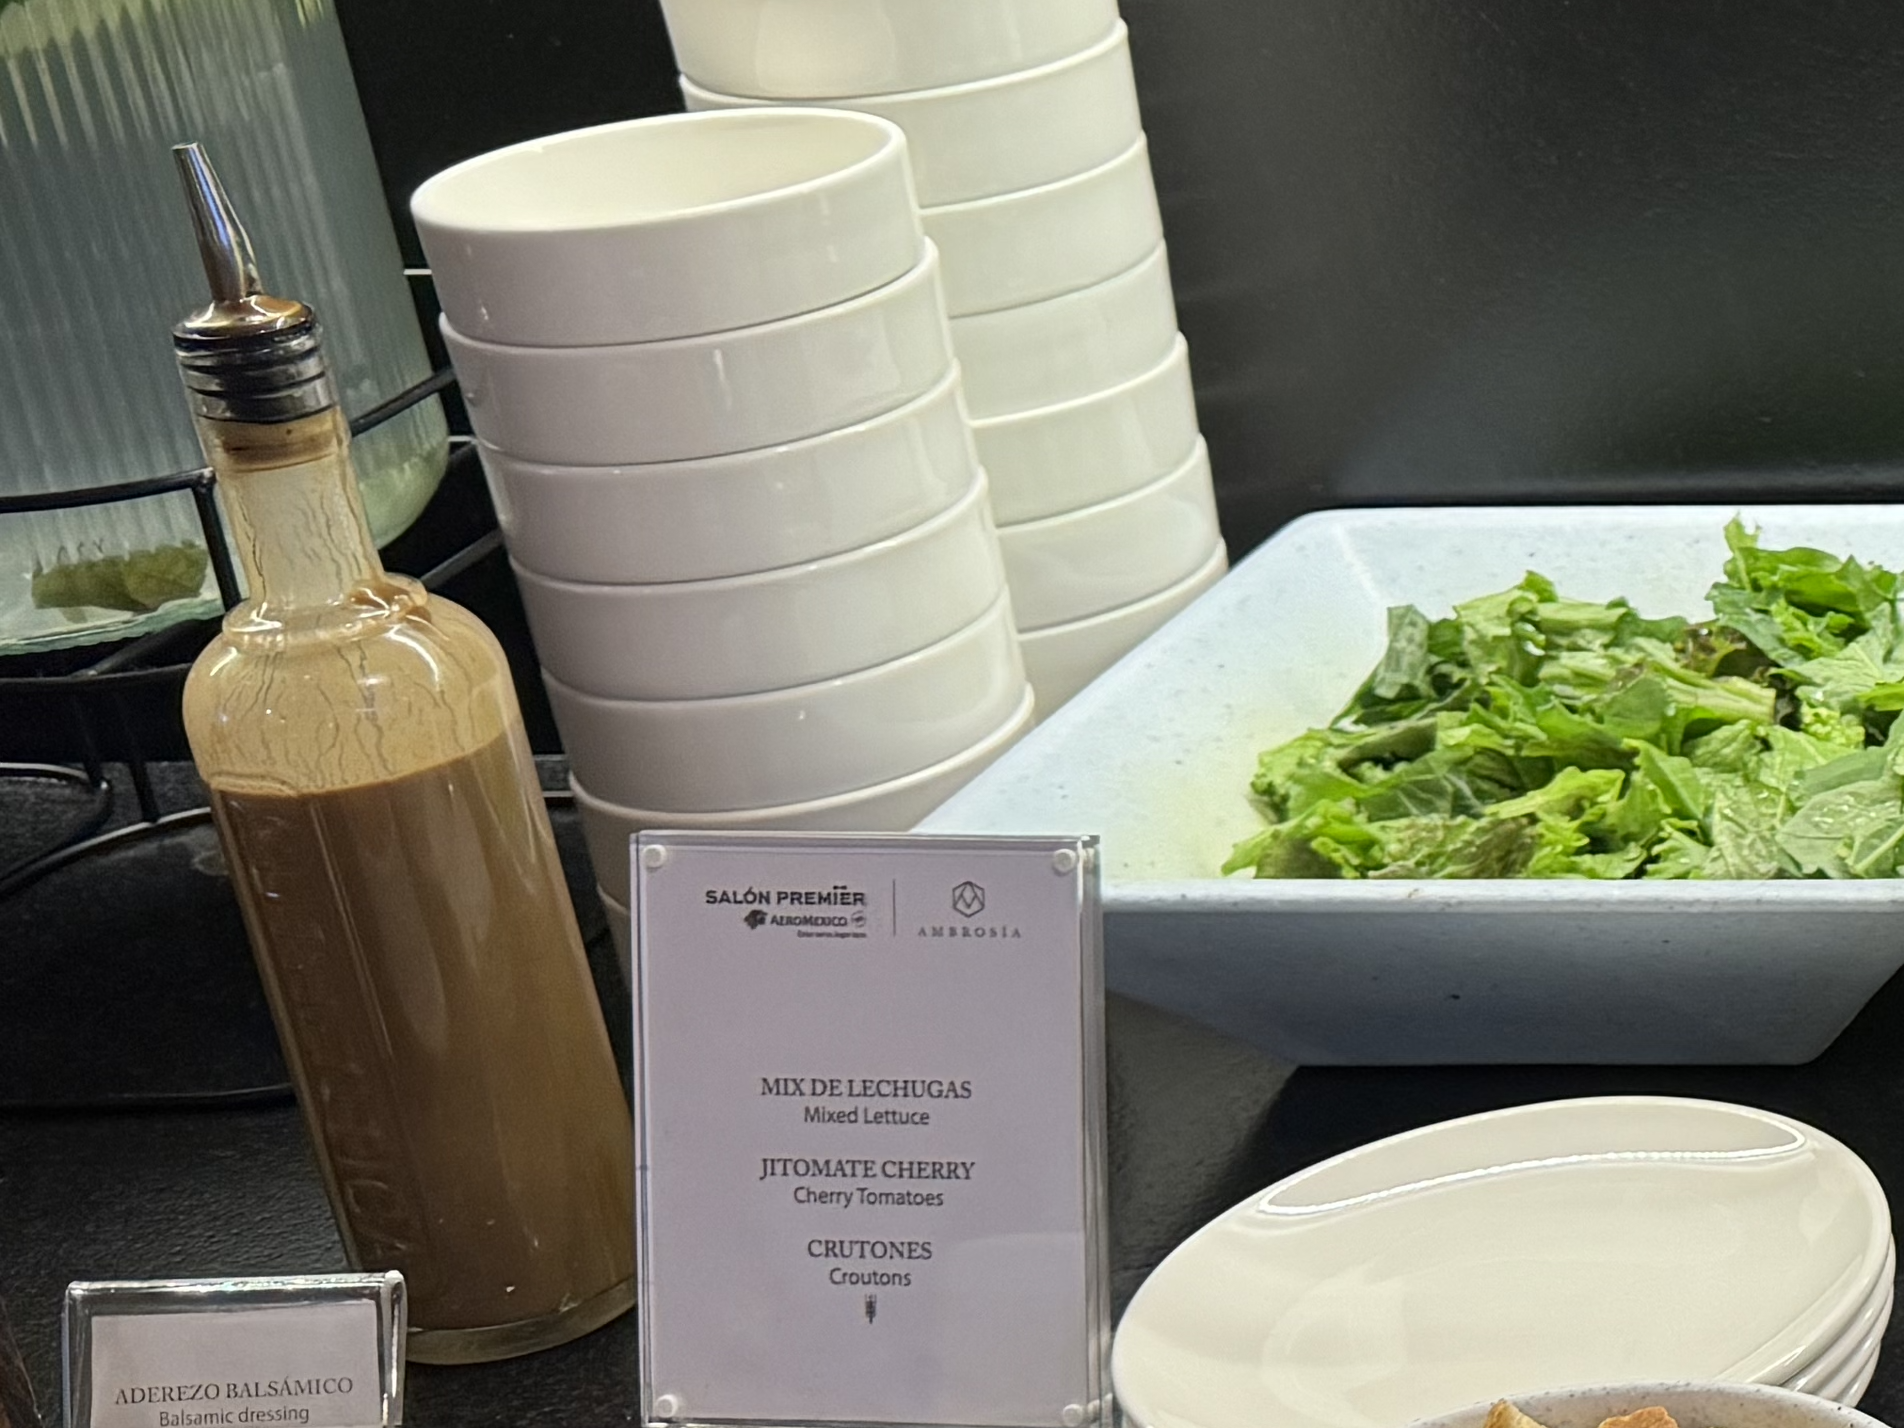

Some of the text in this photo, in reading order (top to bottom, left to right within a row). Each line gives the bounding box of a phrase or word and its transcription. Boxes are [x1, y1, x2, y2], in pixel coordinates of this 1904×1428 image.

[705, 886, 771, 906] SALÓN
[760, 1077, 973, 1099] MIX DE LECHUGAS
[804, 1106, 930, 1125] Mixed Lettuce
[759, 1158, 975, 1180] JITOMATE CHERRY
[793, 1186, 944, 1208] Cherry Tomatoes
[807, 1238, 933, 1261] CRUTONES
[829, 1267, 912, 1288] Croutons
[115, 1376, 354, 1405] ADEREZO BALSÁMICO
[159, 1406, 310, 1427] Balsamic dressing
